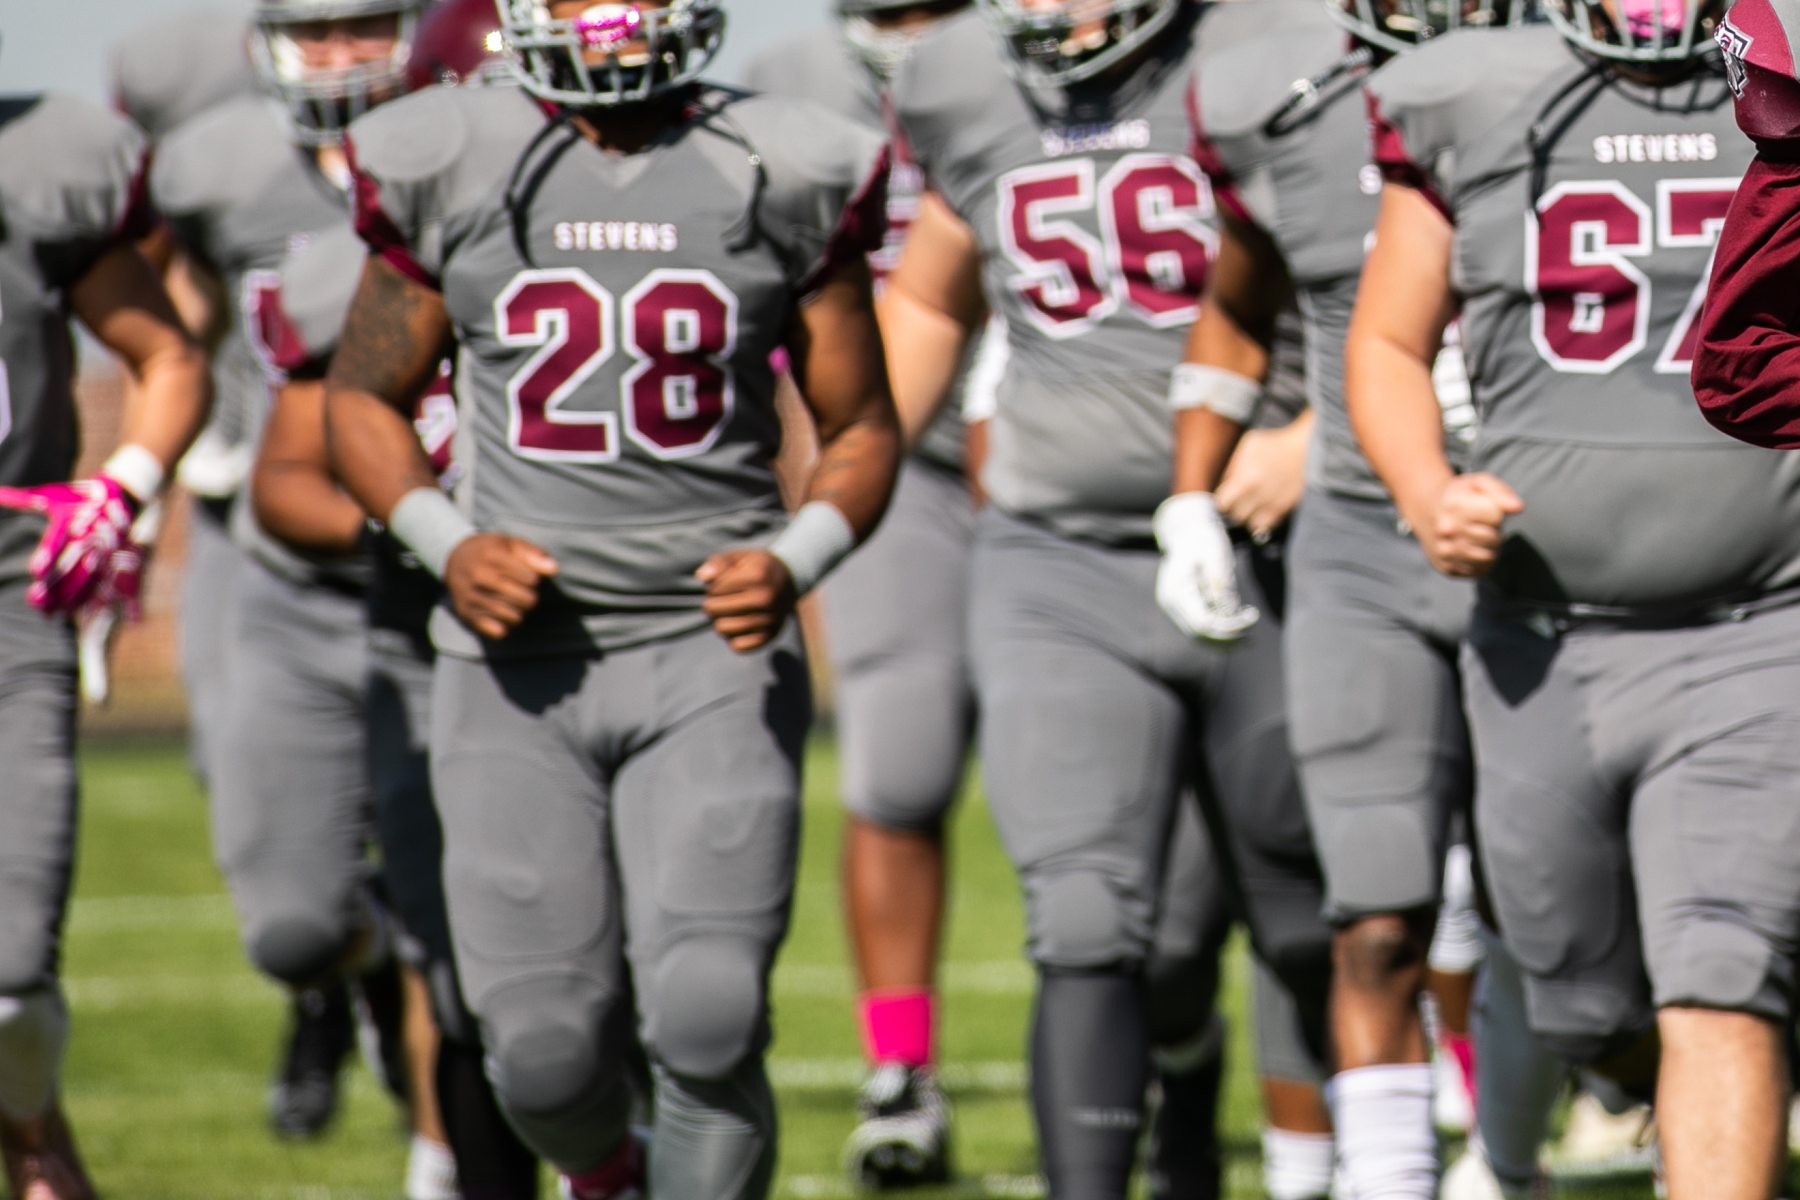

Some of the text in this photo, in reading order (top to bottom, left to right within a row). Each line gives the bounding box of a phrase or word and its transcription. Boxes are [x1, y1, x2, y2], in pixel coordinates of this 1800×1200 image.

[553, 220, 679, 252] STEVENS
[1592, 132, 1718, 163] STEVENS
[995, 152, 1221, 340] 56
[1523, 176, 1745, 375] 67
[492, 266, 740, 463] 28
